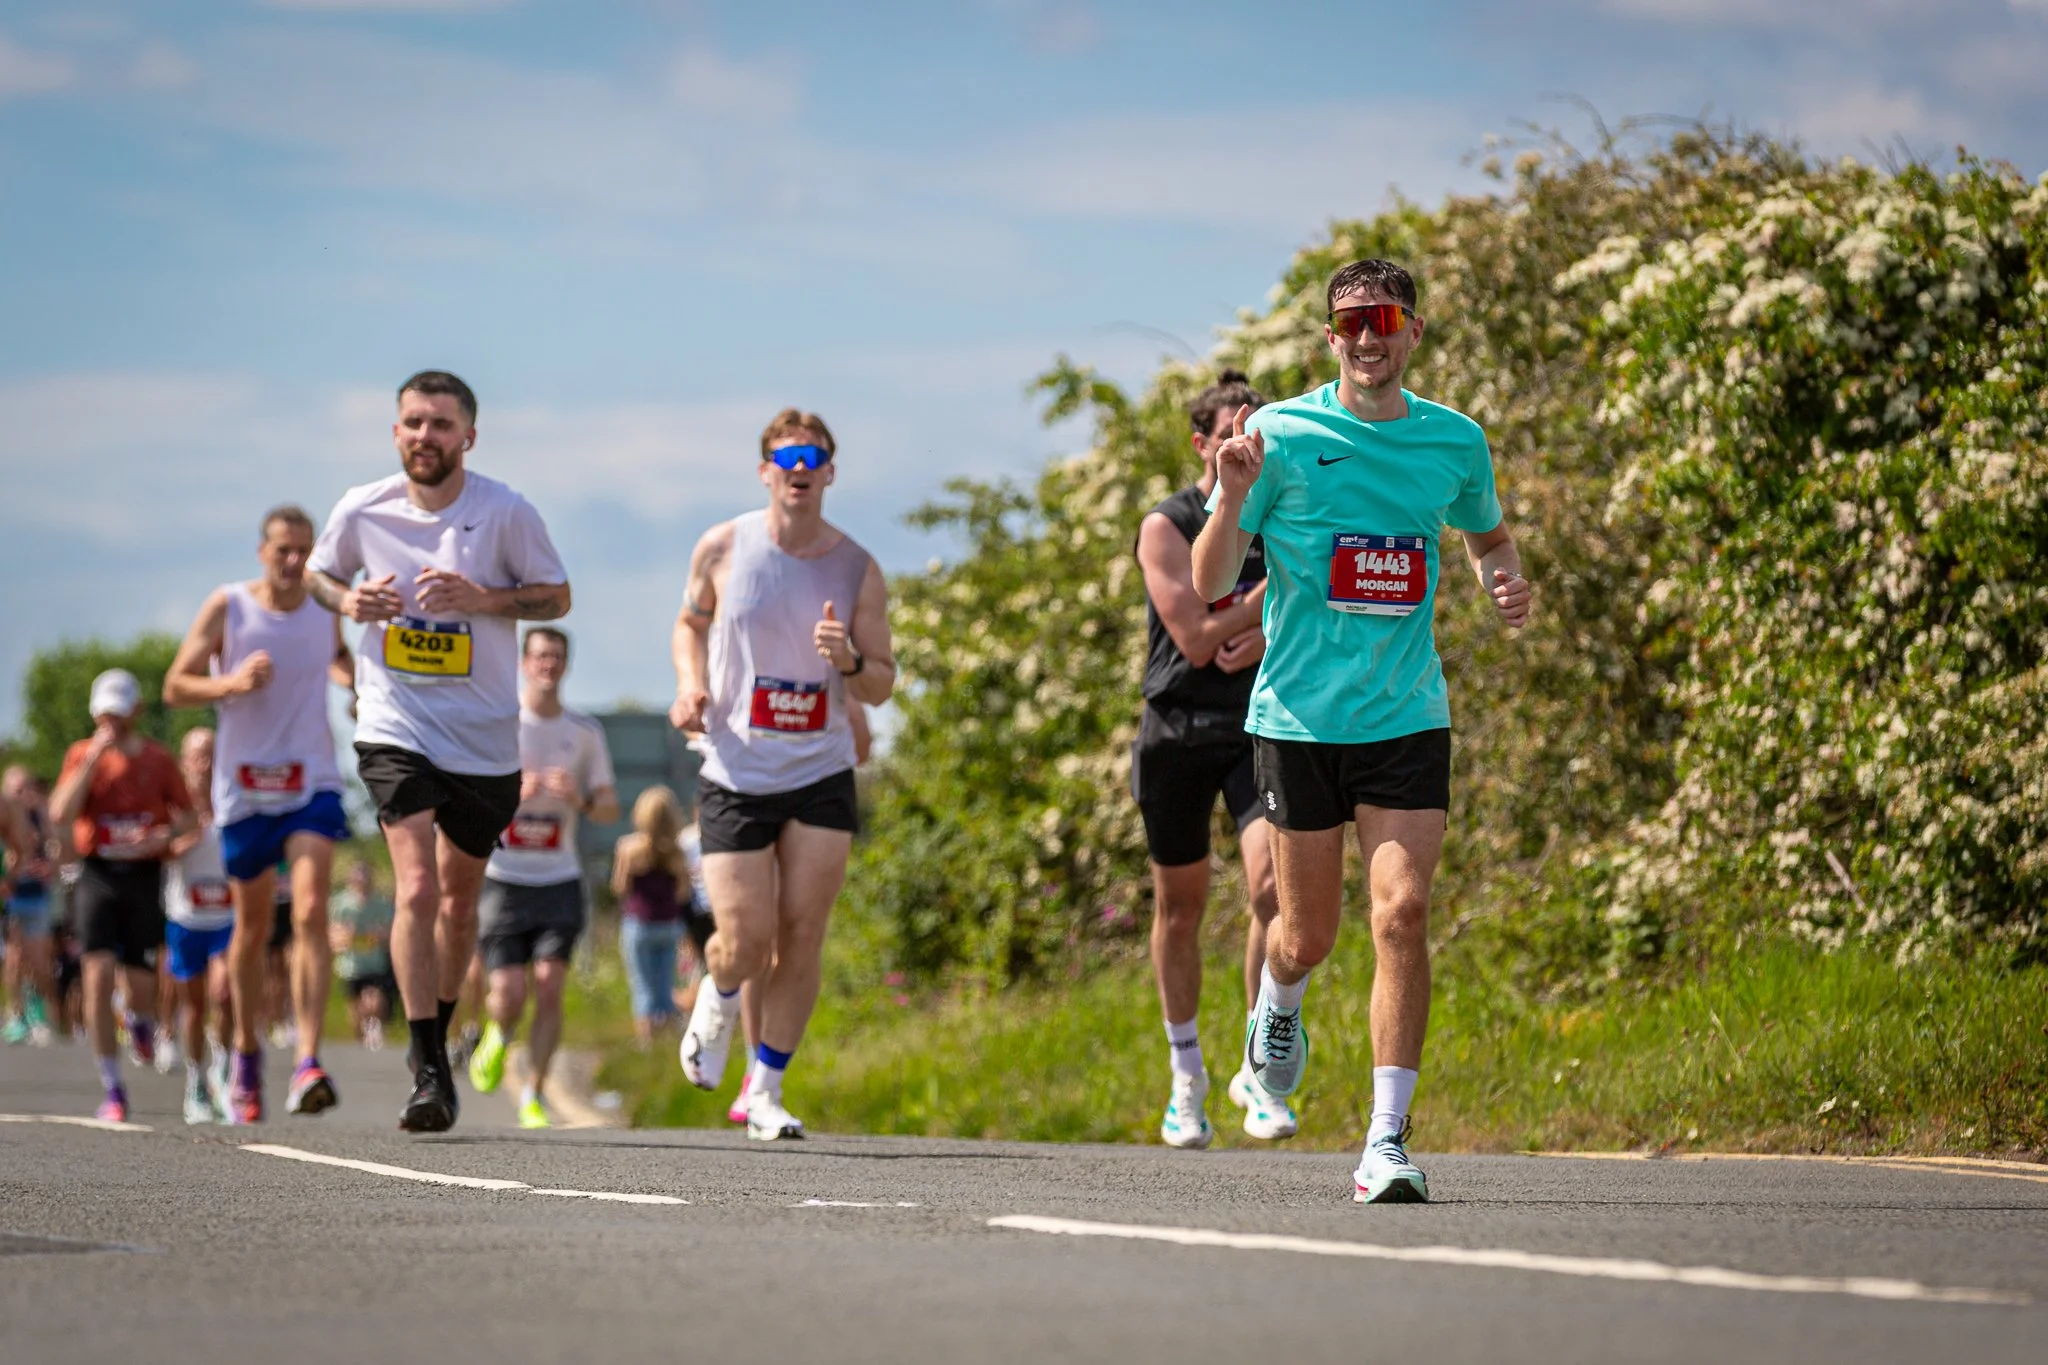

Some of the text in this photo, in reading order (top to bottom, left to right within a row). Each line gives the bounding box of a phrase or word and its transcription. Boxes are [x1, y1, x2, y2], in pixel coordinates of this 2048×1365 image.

[1354, 551, 1411, 576] 1443
[1355, 578, 1408, 592] MORGAN
[399, 631, 455, 653] 4203
